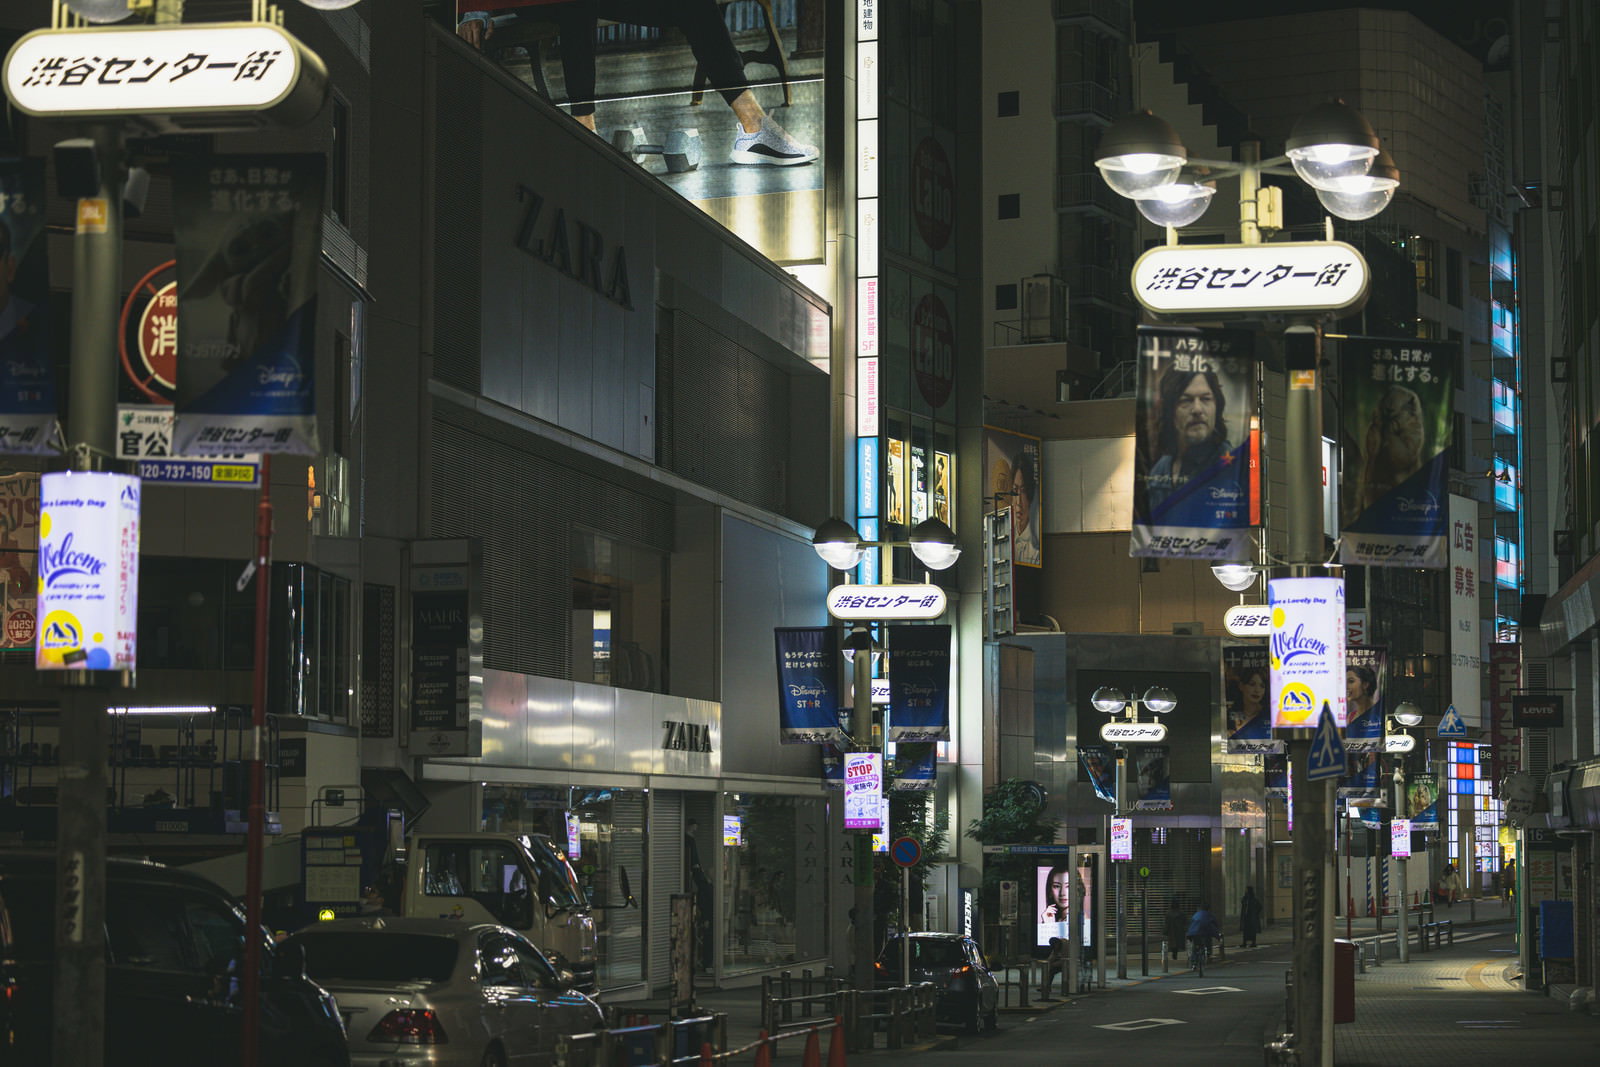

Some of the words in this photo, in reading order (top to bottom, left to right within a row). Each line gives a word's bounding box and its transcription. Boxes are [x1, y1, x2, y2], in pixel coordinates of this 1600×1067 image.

[22, 50, 282, 87] 渋谷センター街
[514, 184, 634, 311] ZARA
[1146, 262, 1352, 292] 渋谷センター街
[159, 295, 177, 308] FIR
[1175, 339, 1231, 352] ハラハラが
[1372, 349, 1432, 362] さあ、日常が
[1370, 364, 1440, 384] 進化する。
[197, 427, 292, 443] 渋谷センター街
[140, 464, 211, 479] 120-737-150
[1149, 536, 1231, 549] 渋谷センター街
[1454, 520, 1473, 552] 広告
[1356, 544, 1438, 556] 渋谷センター街
[834, 595, 938, 608] 渋谷センター街
[1231, 614, 1270, 627] 渋谷セ
[1348, 619, 1362, 645] TAX
[1271, 623, 1329, 664] Welcome
[785, 651, 829, 660] もうディズニー
[785, 661, 830, 669] だけじゃない。
[788, 678, 827, 698] Disney+
[901, 678, 939, 696] Disney+
[662, 719, 714, 754] ZARA
[1105, 728, 1162, 737] 渋谷センター街
[1480, 751, 1492, 759] Be
[847, 764, 872, 777] STOP
[853, 782, 873, 791] 実施中
[1530, 829, 1544, 840] 16
[842, 830, 853, 884] ARA
